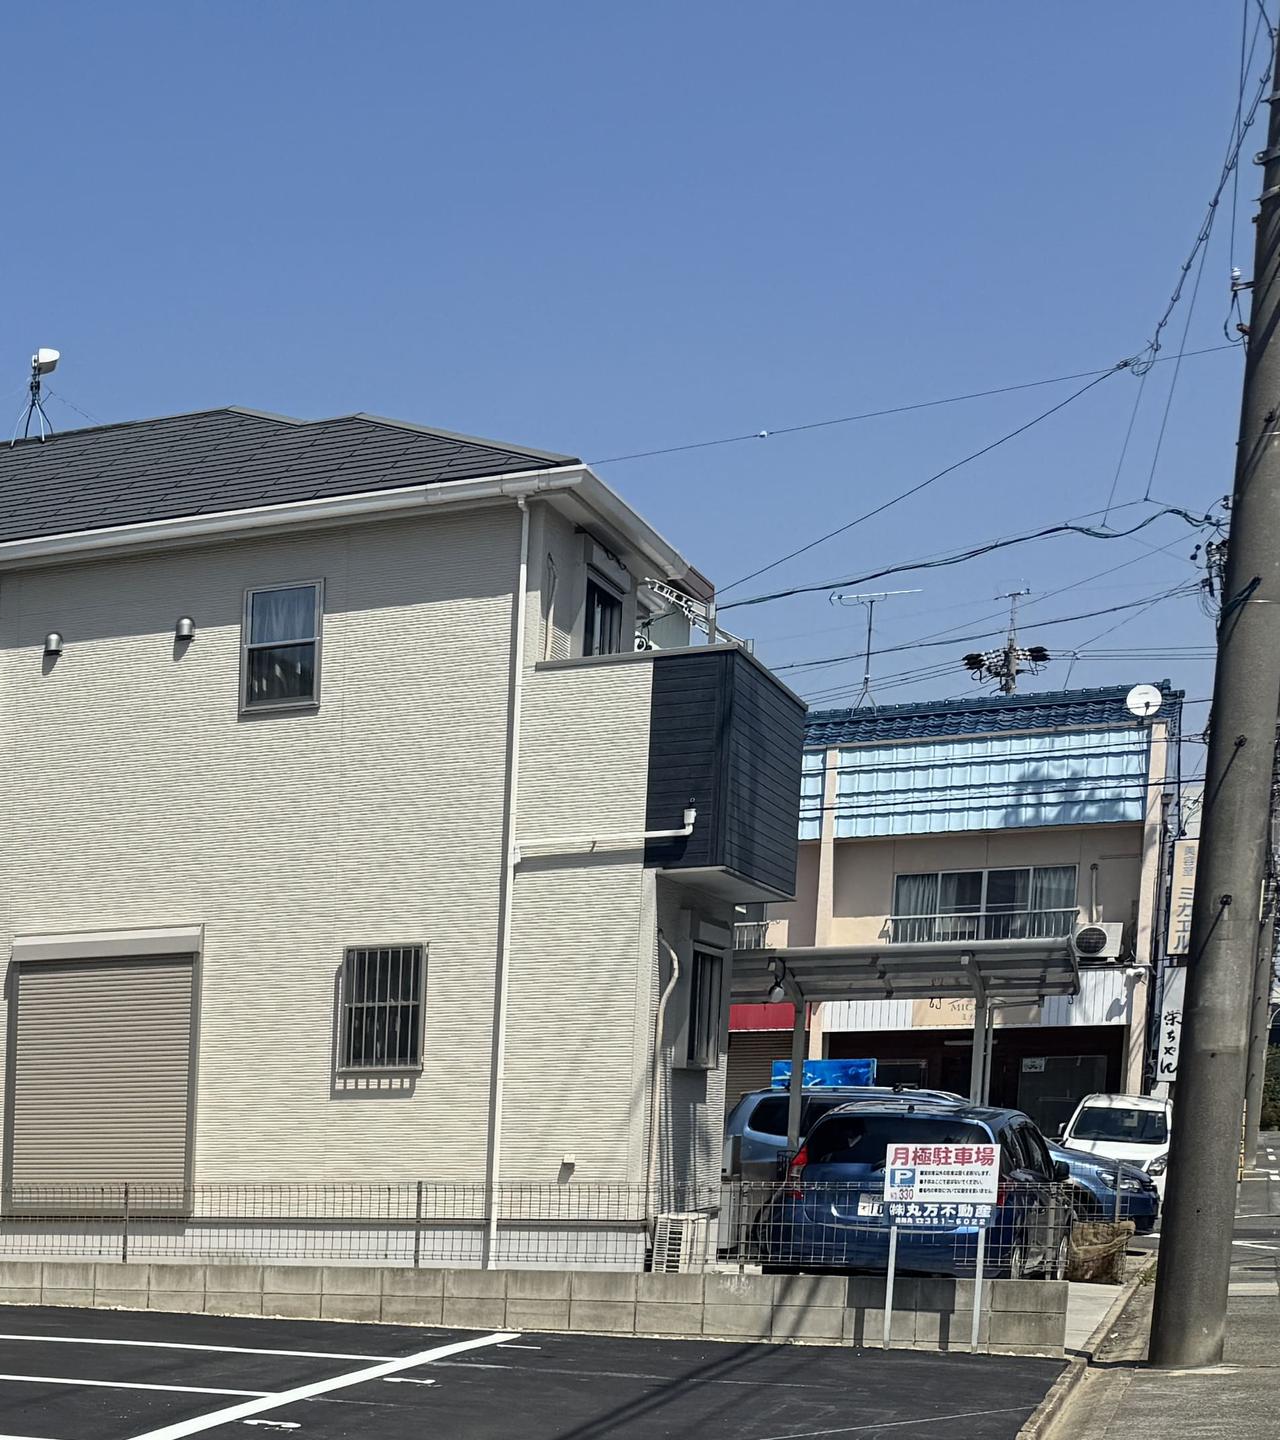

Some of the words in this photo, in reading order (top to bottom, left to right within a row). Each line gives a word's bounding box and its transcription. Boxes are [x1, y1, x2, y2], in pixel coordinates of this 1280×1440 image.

[1173, 887, 1193, 951] ミカエル
[891, 1147, 995, 1166] 月極駐車場
[894, 1169, 913, 1184] P
